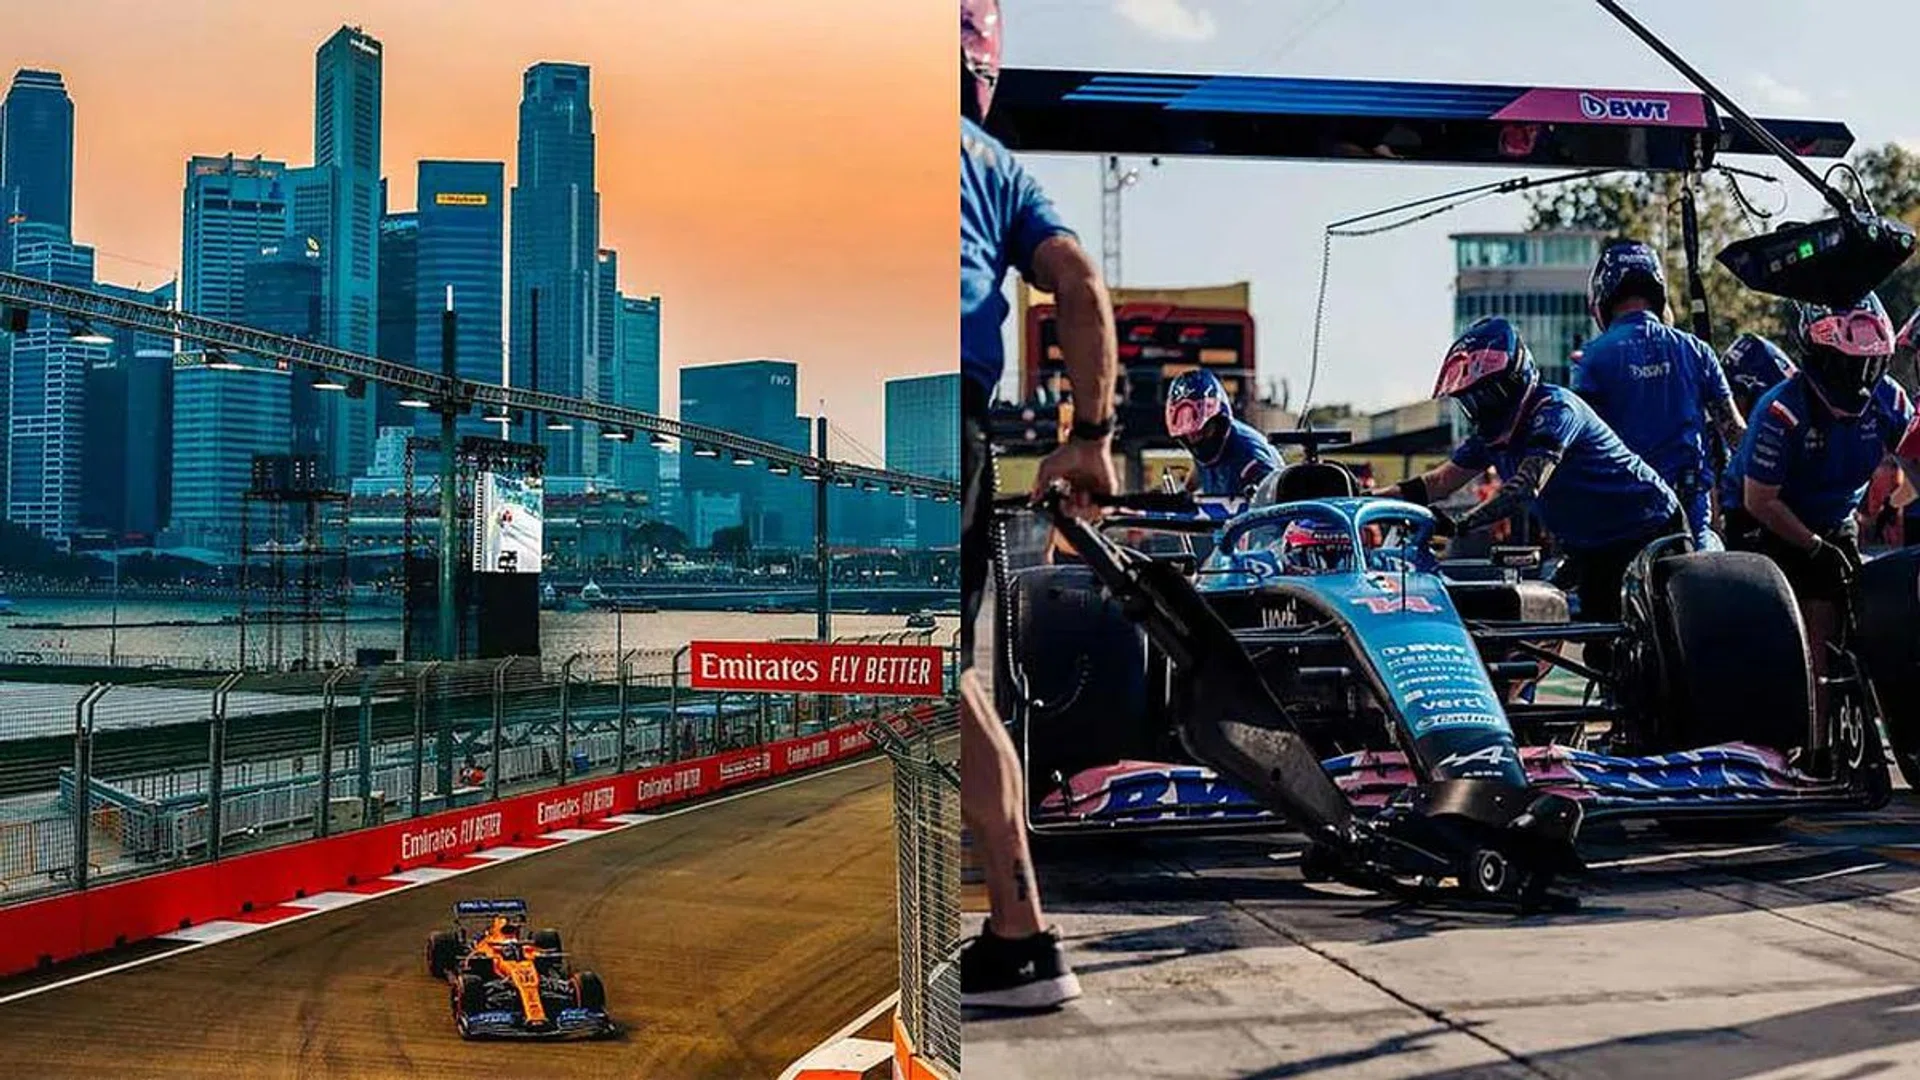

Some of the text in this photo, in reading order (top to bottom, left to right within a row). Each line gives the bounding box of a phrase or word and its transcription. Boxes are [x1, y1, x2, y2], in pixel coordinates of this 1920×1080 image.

[1606, 98, 1670, 120] BWT
[700, 653, 931, 685] Emirates FLY BETTER
[538, 798, 579, 825] Emirates
[402, 827, 457, 860] Emirates
[475, 812, 502, 842] BETTER
